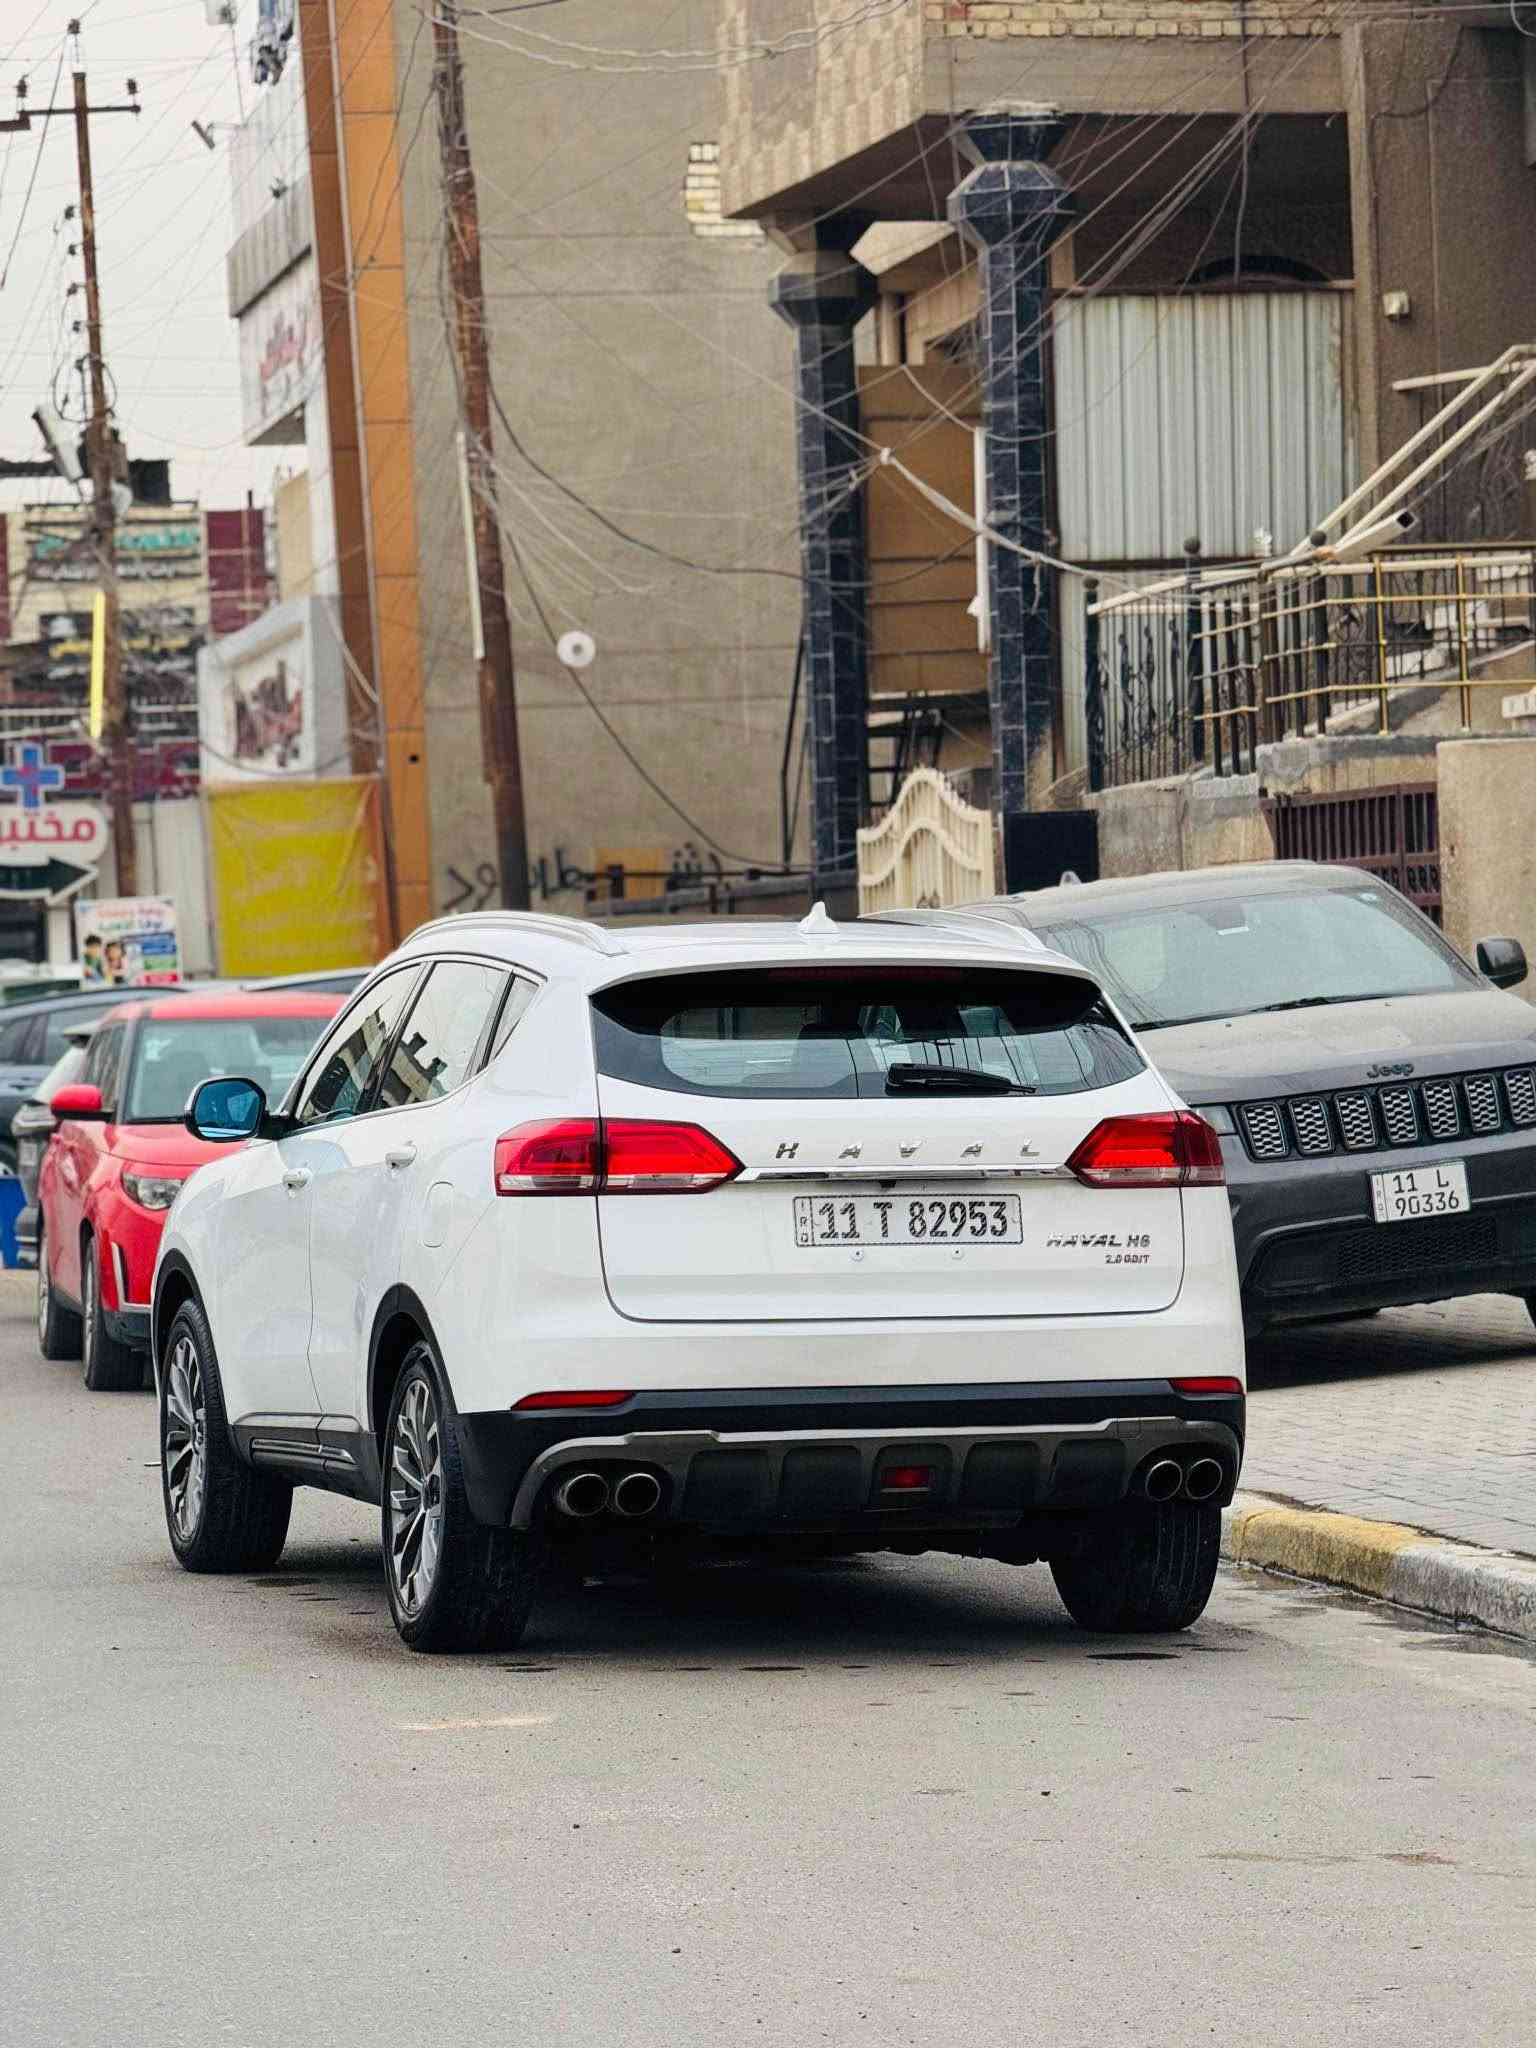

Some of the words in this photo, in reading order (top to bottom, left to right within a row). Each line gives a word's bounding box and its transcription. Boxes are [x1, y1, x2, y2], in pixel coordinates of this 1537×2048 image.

[0, 809, 97, 851] مختب
[1366, 1063, 1415, 1080] Jeep
[776, 1141, 1040, 1159] HAVAL
[1392, 1172, 1419, 1194] 11
[1436, 1169, 1450, 1188] L
[1395, 1190, 1460, 1217] 90336
[818, 1202, 861, 1239] 11
[873, 1201, 893, 1238] T
[908, 1200, 1009, 1238] 82953
[1045, 1233, 1122, 1248] HAVAL
[1126, 1234, 1151, 1248] H6
